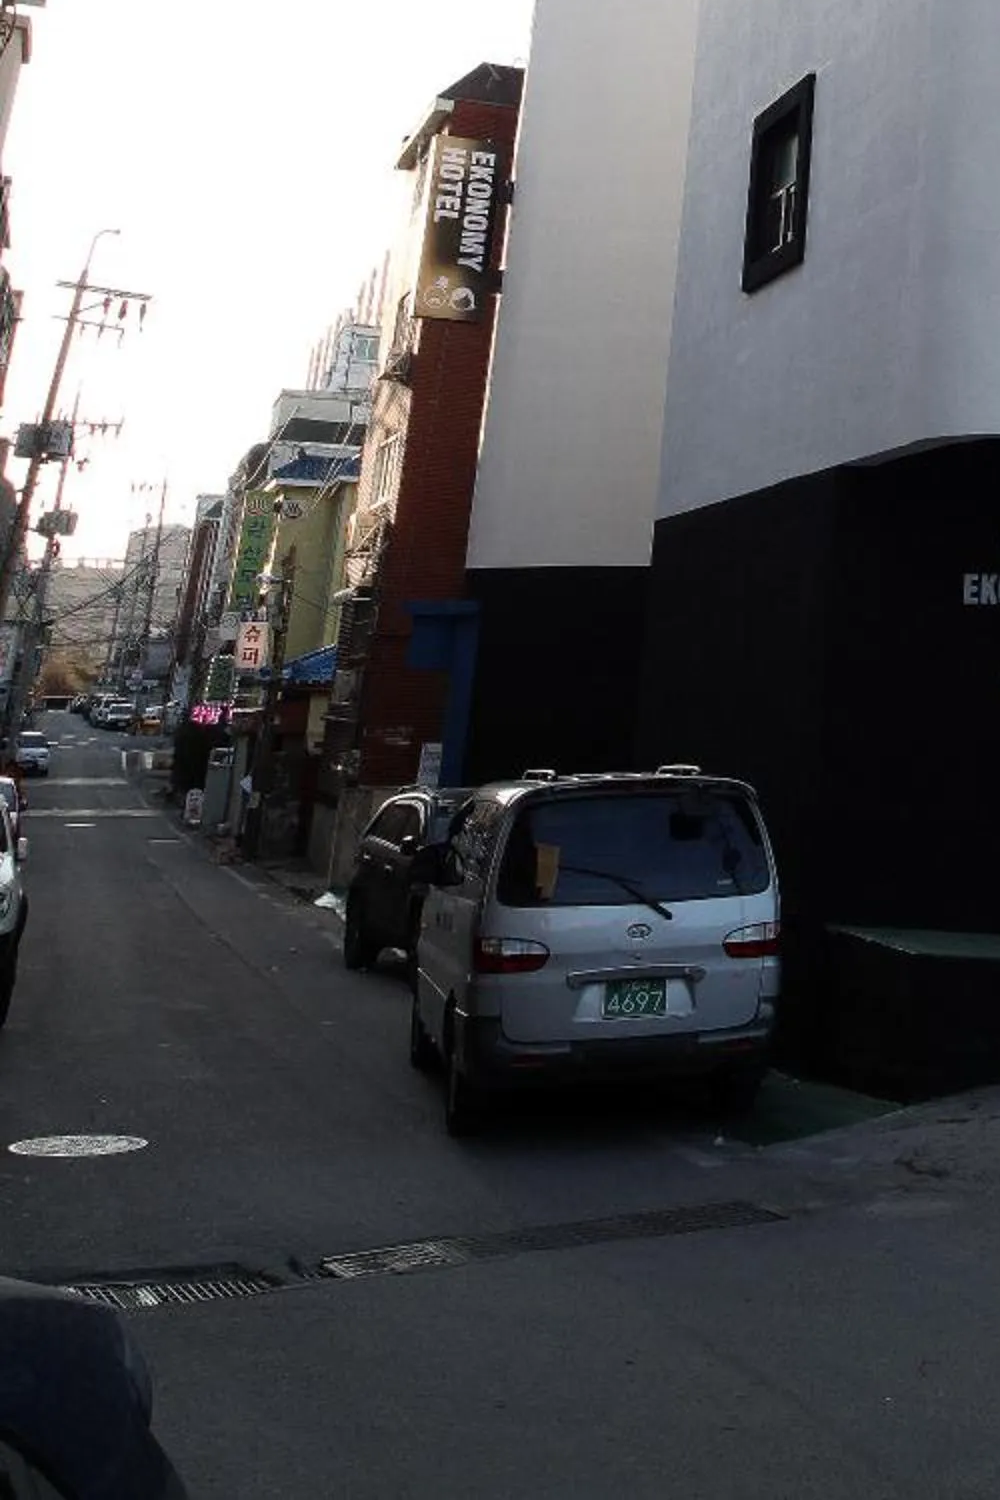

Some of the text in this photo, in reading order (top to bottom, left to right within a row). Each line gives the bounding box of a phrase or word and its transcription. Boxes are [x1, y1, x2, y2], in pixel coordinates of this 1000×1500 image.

[434, 148, 466, 223] HOTEL
[457, 152, 496, 273] EKONOMY
[242, 626, 260, 664] 슈퍼
[607, 990, 664, 1013] 4697
